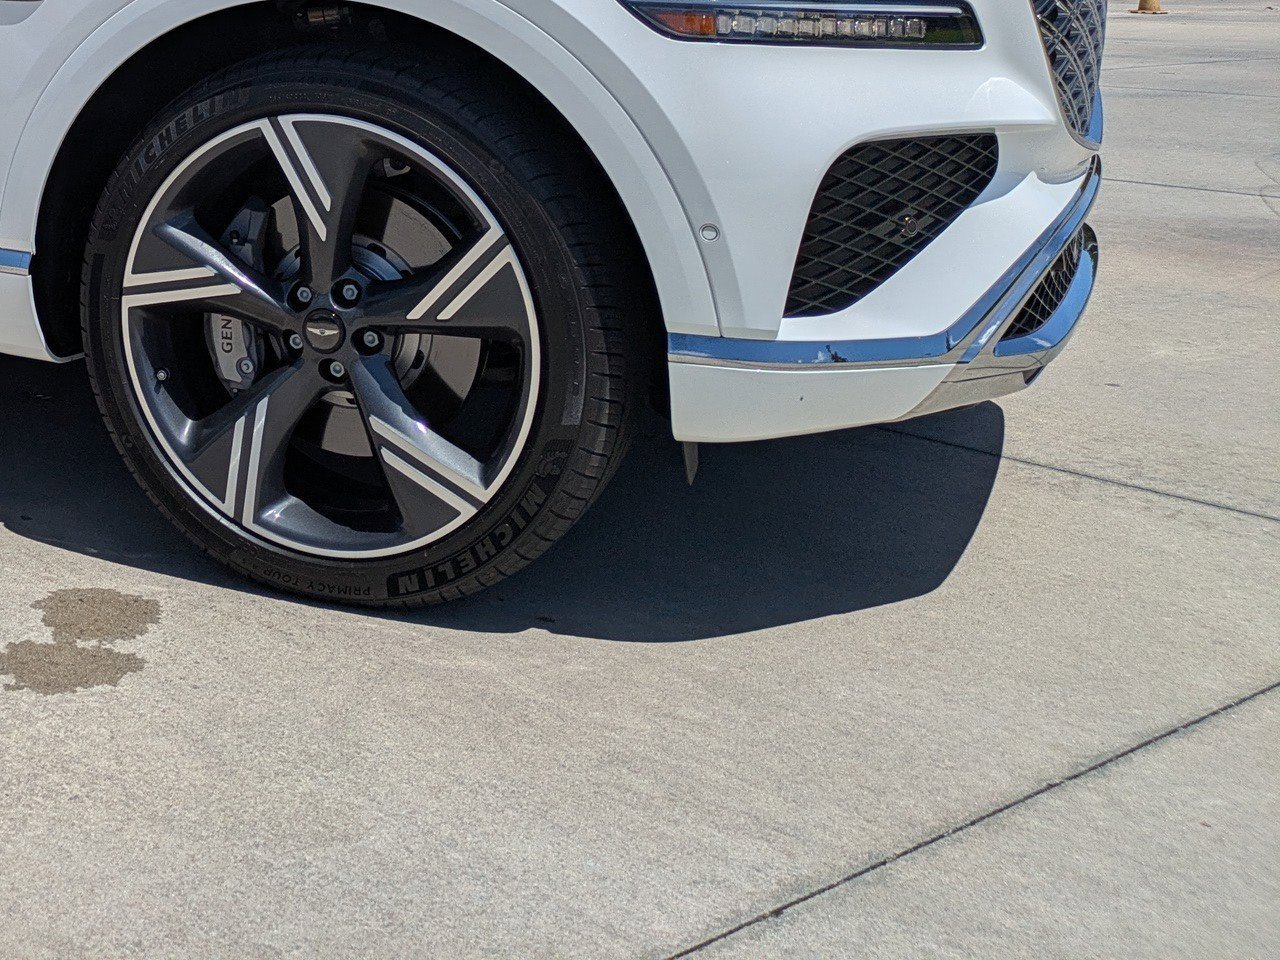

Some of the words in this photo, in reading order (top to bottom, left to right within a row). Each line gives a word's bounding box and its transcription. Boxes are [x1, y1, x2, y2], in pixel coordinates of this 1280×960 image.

[397, 482, 548, 594] MICHELIN
[263, 567, 299, 586] TOUR
[306, 581, 370, 596] PRIMACY
